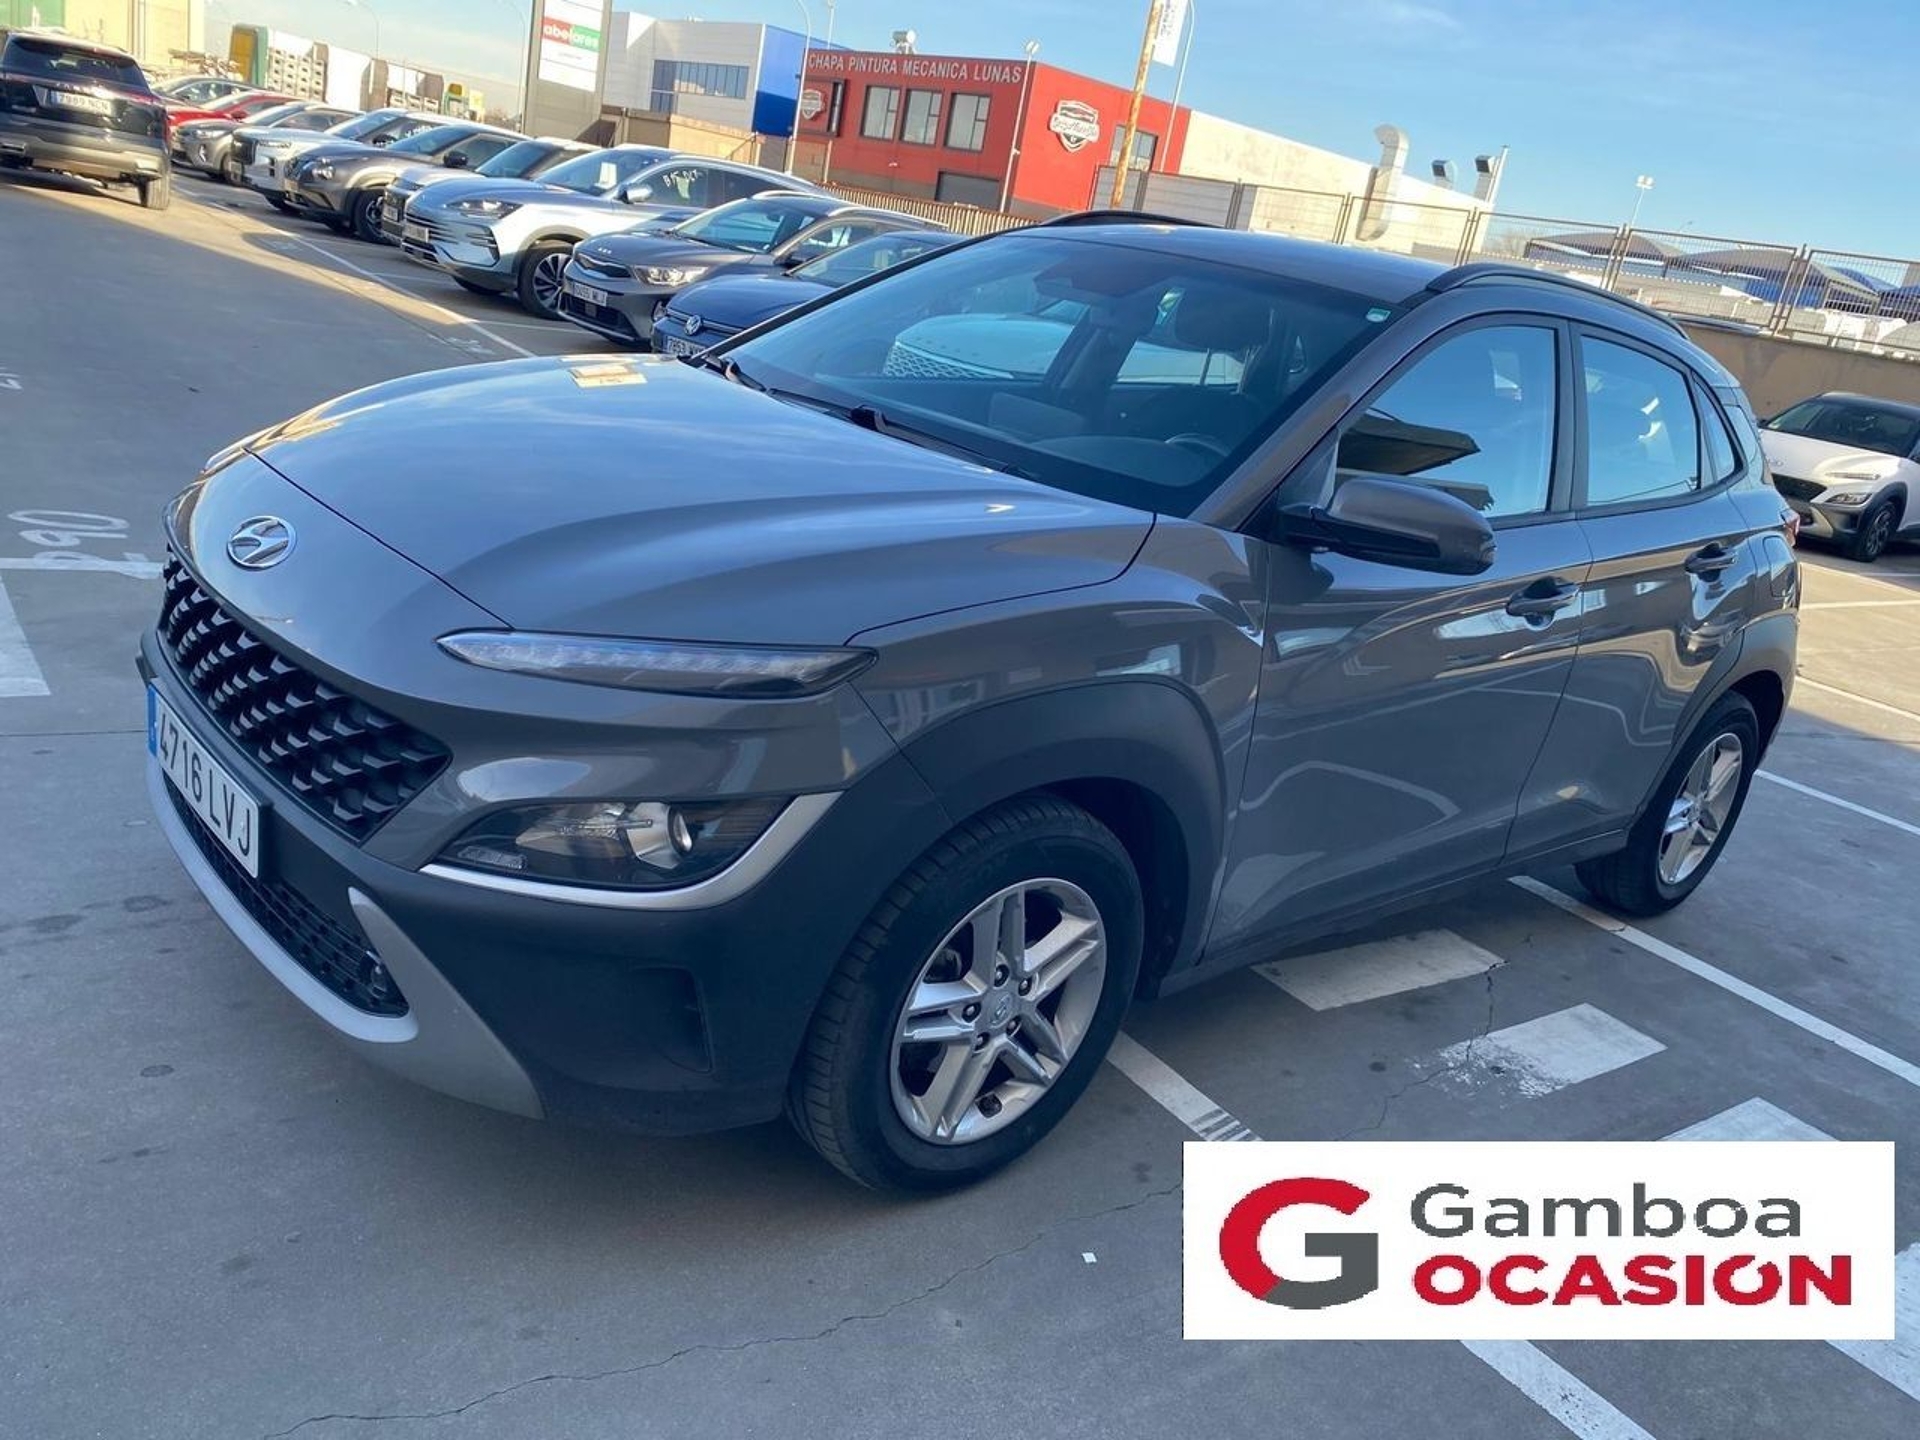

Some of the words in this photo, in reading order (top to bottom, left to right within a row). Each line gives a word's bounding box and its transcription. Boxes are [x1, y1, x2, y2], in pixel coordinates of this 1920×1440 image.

[808, 53, 844, 70] CHAPA
[849, 56, 898, 74] PINTURA
[903, 59, 968, 79] MECANICA
[974, 64, 1023, 83] LUNAS
[160, 712, 203, 804] 4716
[209, 768, 251, 857] LVJ
